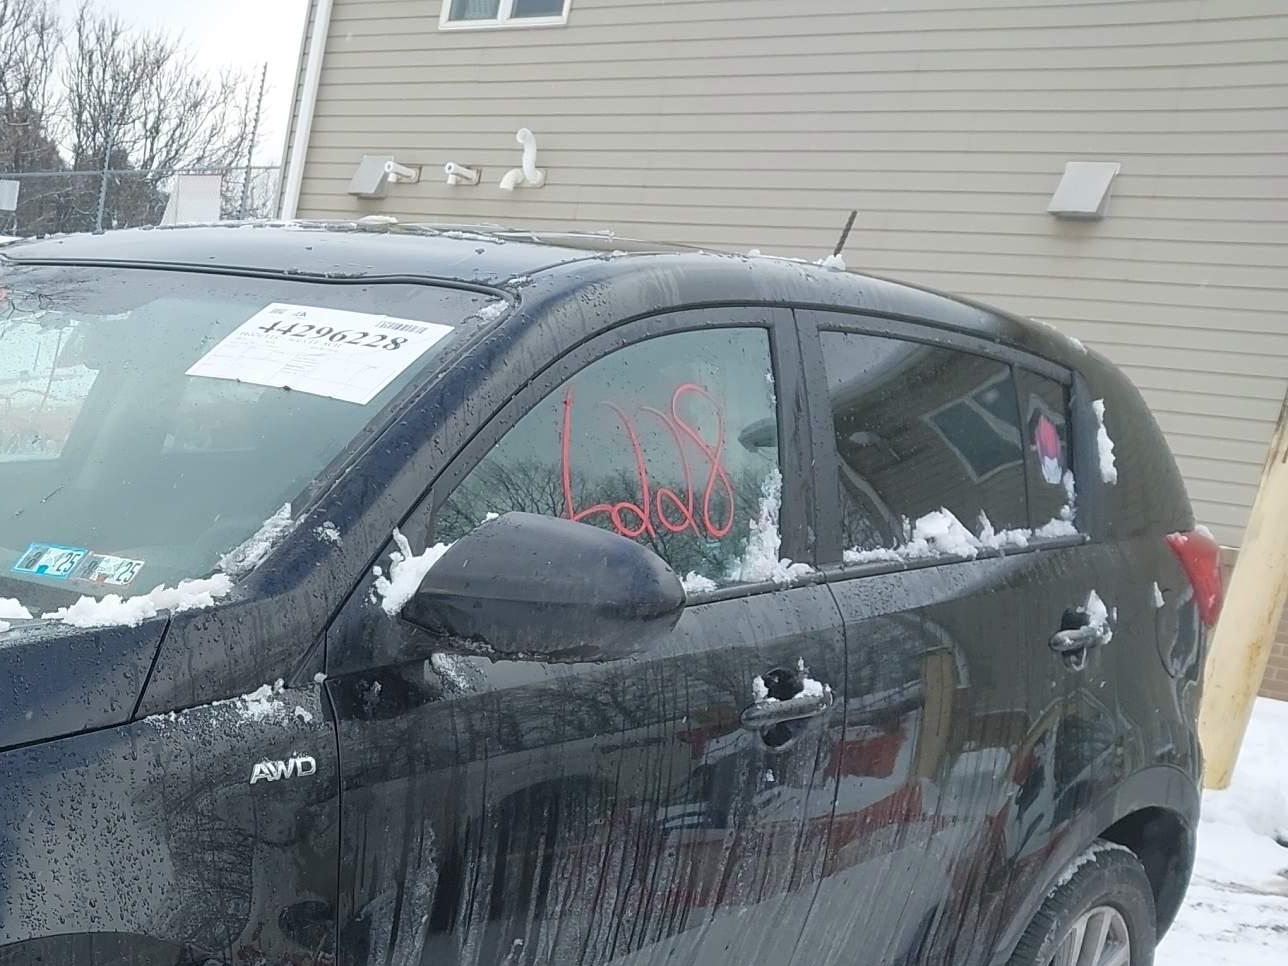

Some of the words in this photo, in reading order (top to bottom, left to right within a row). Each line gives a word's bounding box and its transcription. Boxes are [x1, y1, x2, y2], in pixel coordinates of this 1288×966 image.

[257, 320, 409, 351] 44296228
[56, 552, 81, 573] 25
[115, 561, 141, 583] 25
[249, 755, 317, 785] AWD
